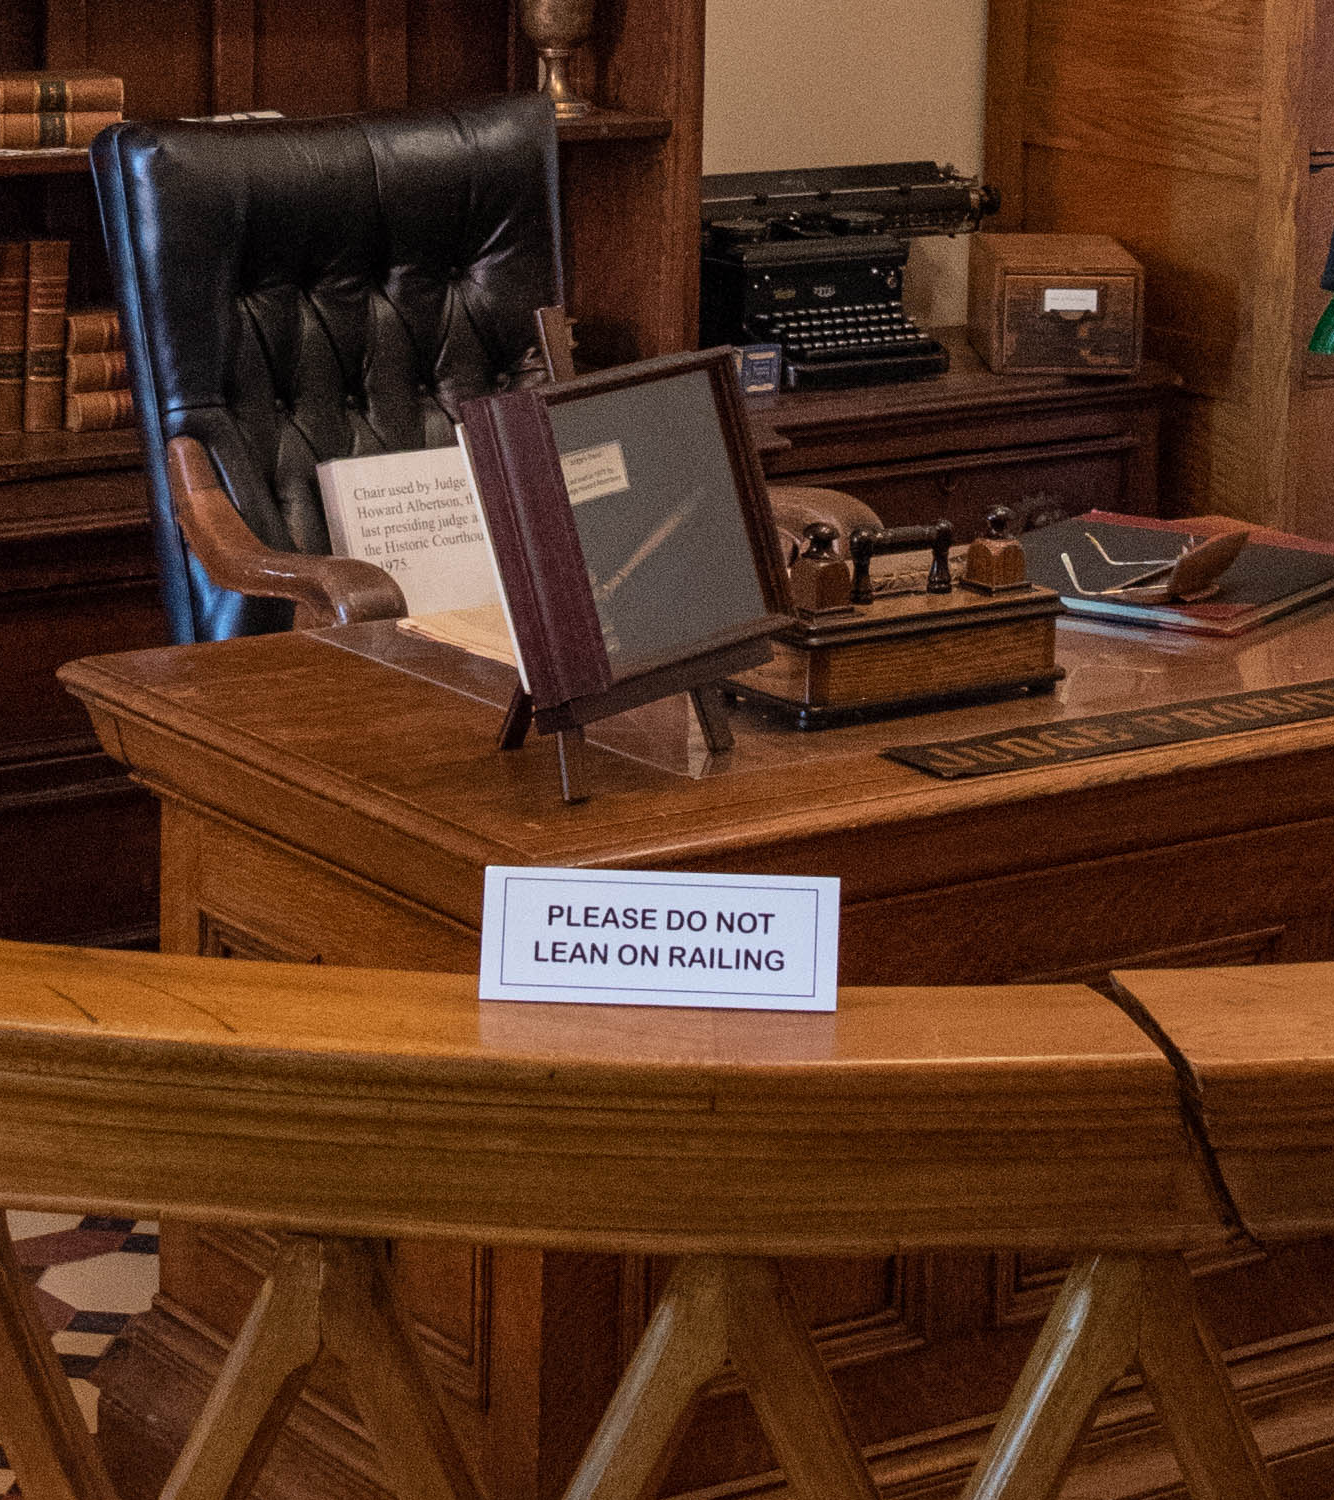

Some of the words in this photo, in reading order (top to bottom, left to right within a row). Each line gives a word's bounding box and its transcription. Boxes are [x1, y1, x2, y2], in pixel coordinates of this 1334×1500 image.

[354, 487, 386, 501] Chair
[388, 481, 414, 496] used
[416, 479, 431, 495] by
[435, 476, 466, 492] Judge
[357, 502, 403, 519] Howard
[407, 498, 464, 515] Albertson,
[360, 525, 381, 538] last
[384, 517, 436, 539] presiding
[439, 513, 468, 532] judge
[364, 543, 383, 556] the
[385, 537, 430, 555] Historic
[432, 531, 485, 547] Courthou
[547, 904, 657, 930] PLEASE
[666, 909, 707, 932] DO
[716, 911, 775, 935] NOT
[533, 940, 608, 965] LEAN
[617, 943, 659, 967] ON
[668, 945, 785, 971] RAILING
